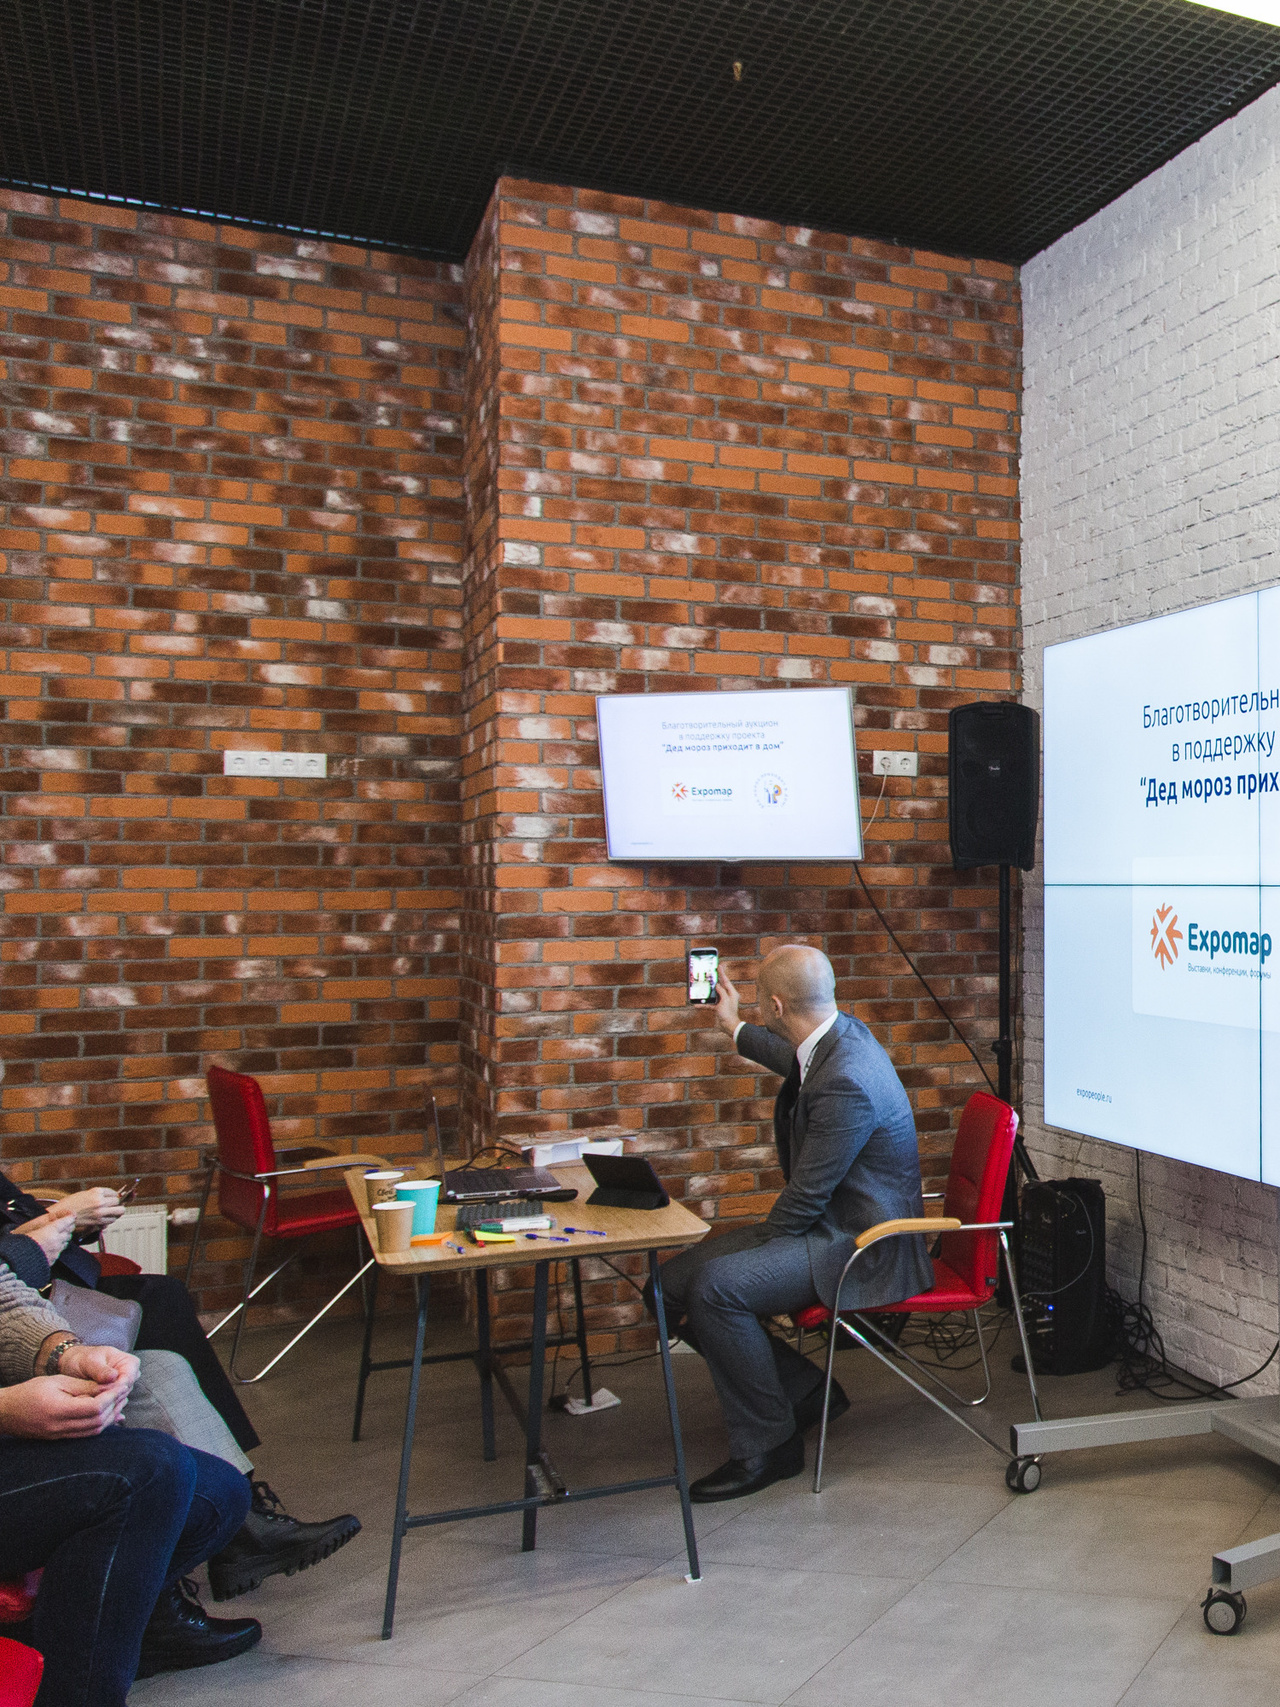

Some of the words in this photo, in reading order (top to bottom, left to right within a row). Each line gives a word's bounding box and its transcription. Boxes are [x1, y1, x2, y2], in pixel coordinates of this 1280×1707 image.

[661, 719, 743, 730] Благотворительный
[744, 719, 779, 729] аукцион
[732, 731, 765, 740] проекта
[685, 743, 711, 752] мороз
[712, 742, 753, 752] приходит
[1172, 743, 1180, 762] в
[1184, 731, 1276, 763] поддержку
[691, 786, 733, 797] Expomap
[1182, 776, 1232, 804] мороз
[1188, 923, 1272, 965] Expomap
